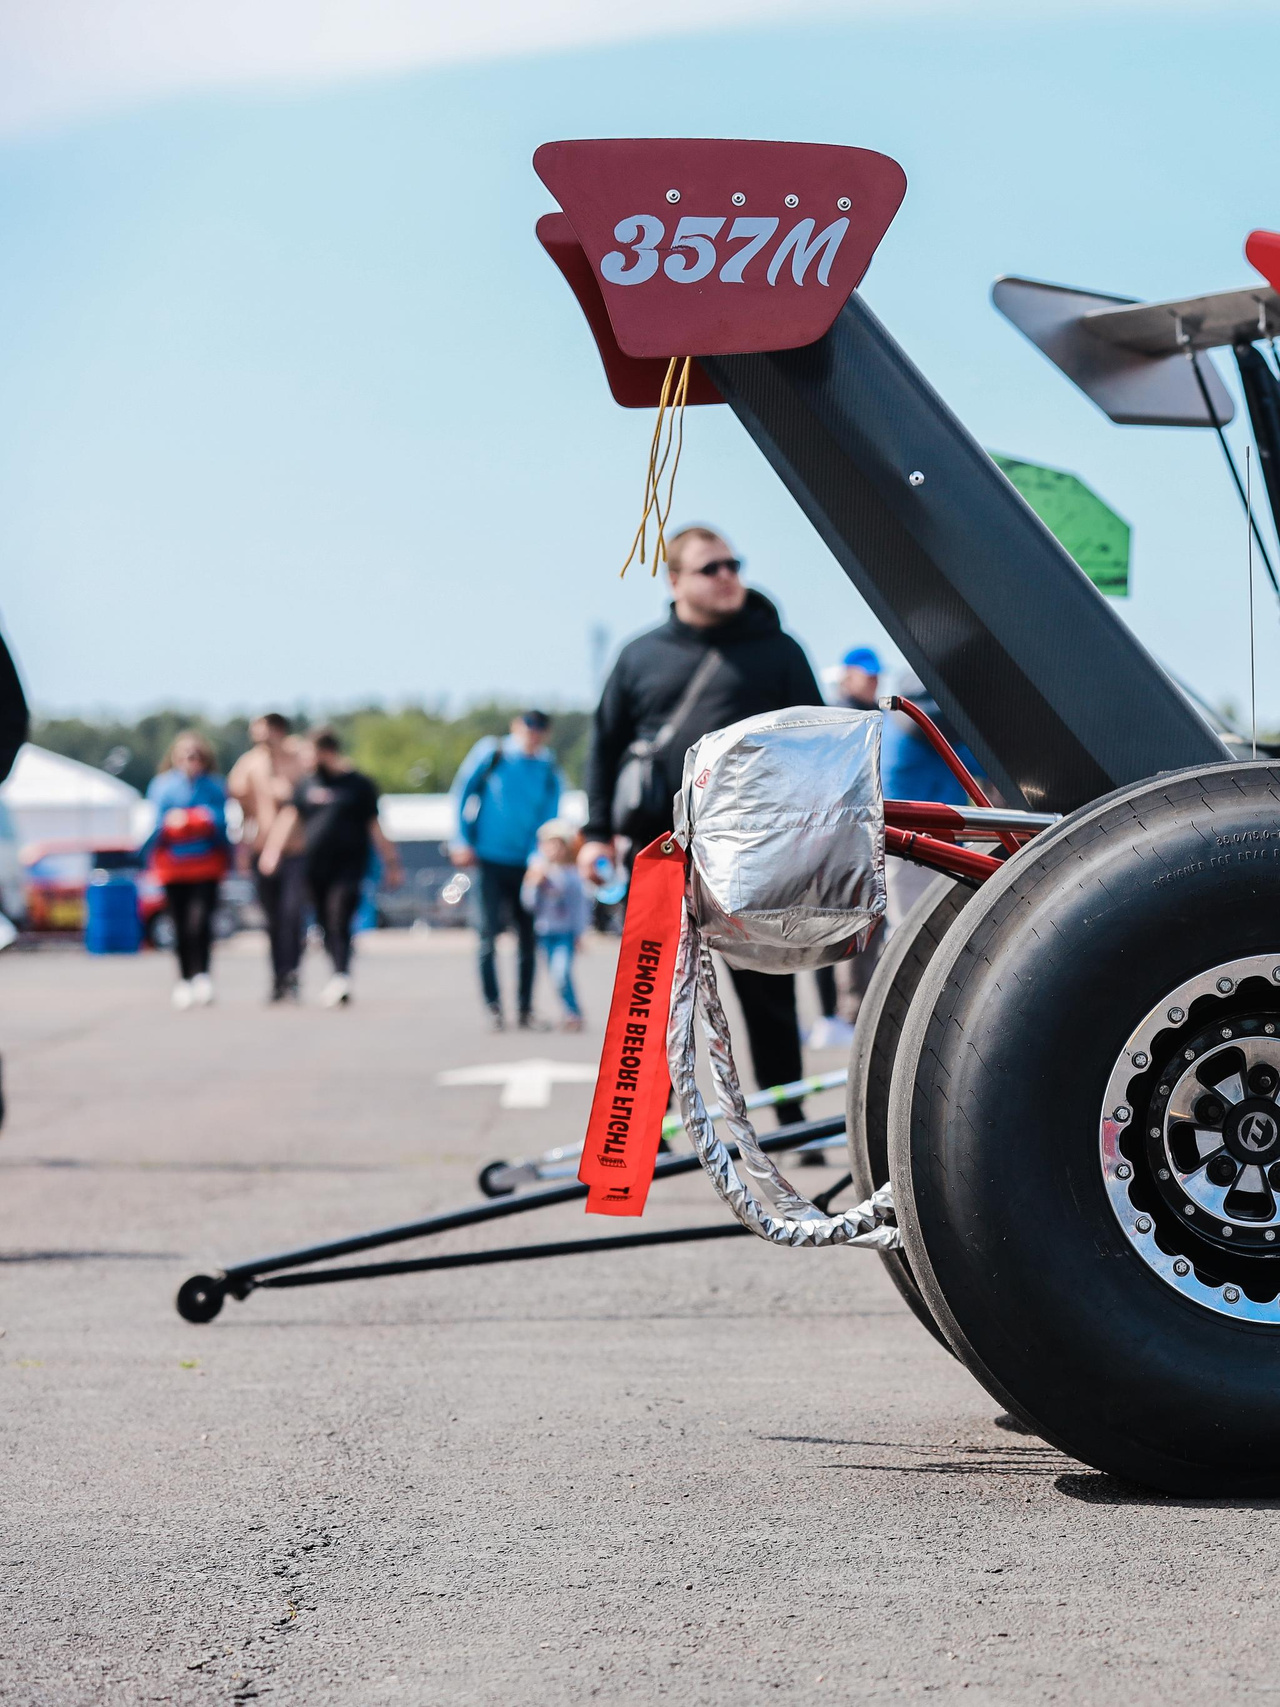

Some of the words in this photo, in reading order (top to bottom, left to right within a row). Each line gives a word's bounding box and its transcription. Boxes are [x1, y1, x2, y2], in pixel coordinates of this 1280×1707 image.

[601, 214, 850, 287] 357M
[1152, 861, 1207, 891] DESIGNED
[1210, 853, 1231, 868] FOR
[1238, 850, 1268, 863] DRAG
